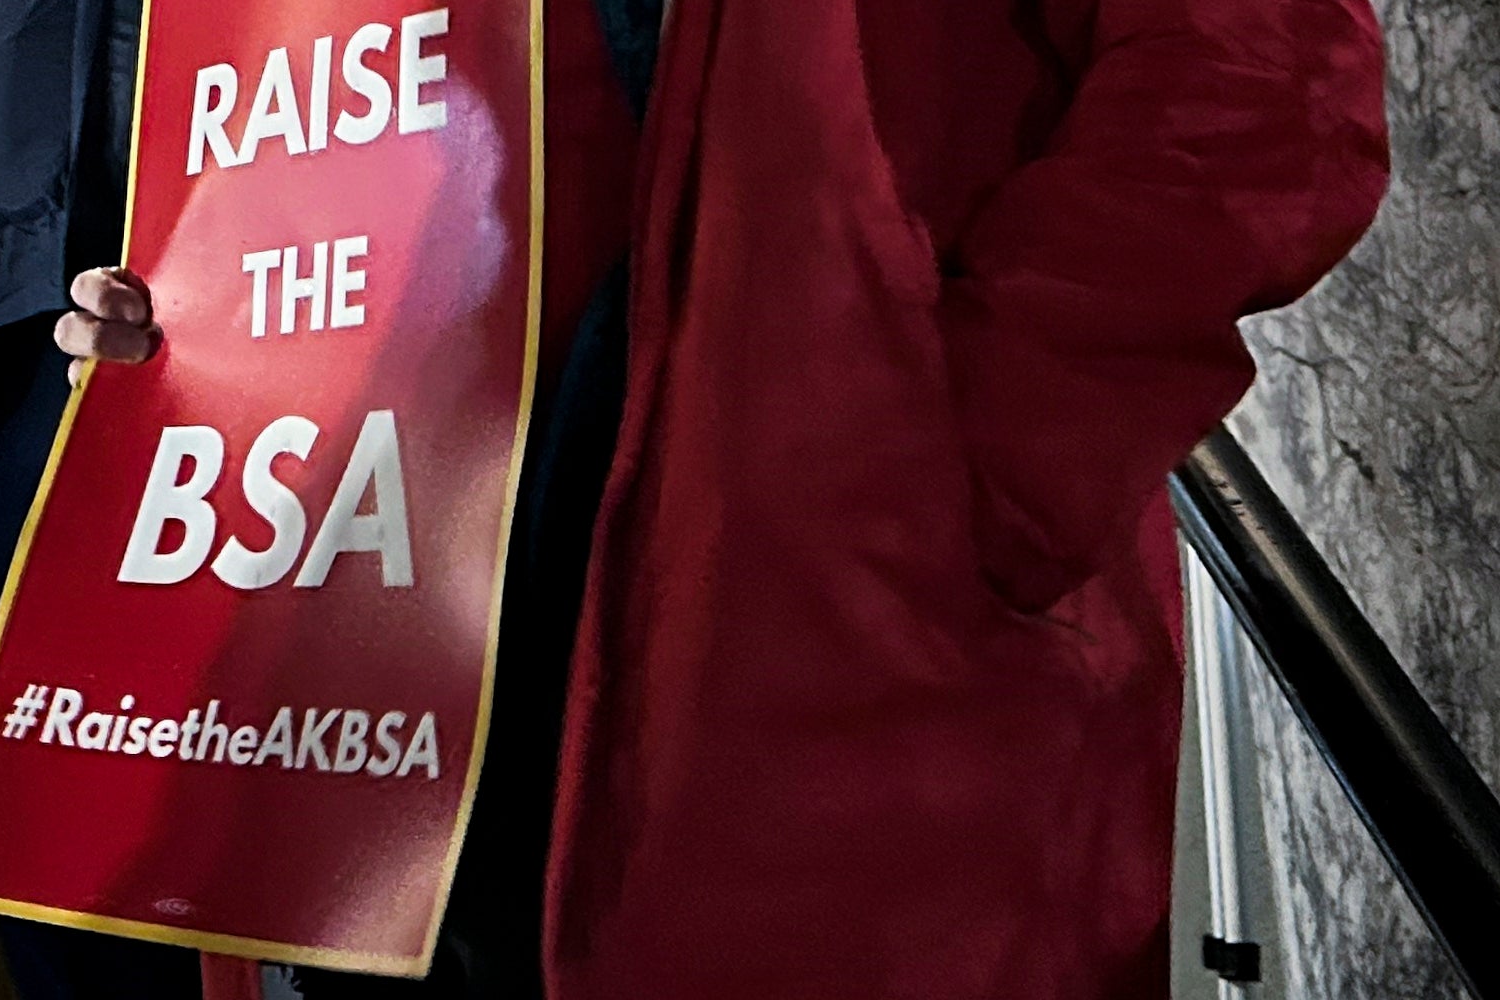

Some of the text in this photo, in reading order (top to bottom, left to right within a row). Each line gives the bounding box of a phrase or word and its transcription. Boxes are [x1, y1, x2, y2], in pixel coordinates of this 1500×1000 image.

[186, 7, 449, 176] RAISE
[242, 235, 368, 338] THE
[117, 409, 414, 590] BSA
[3, 683, 440, 779] #RaisetheAKBSA
